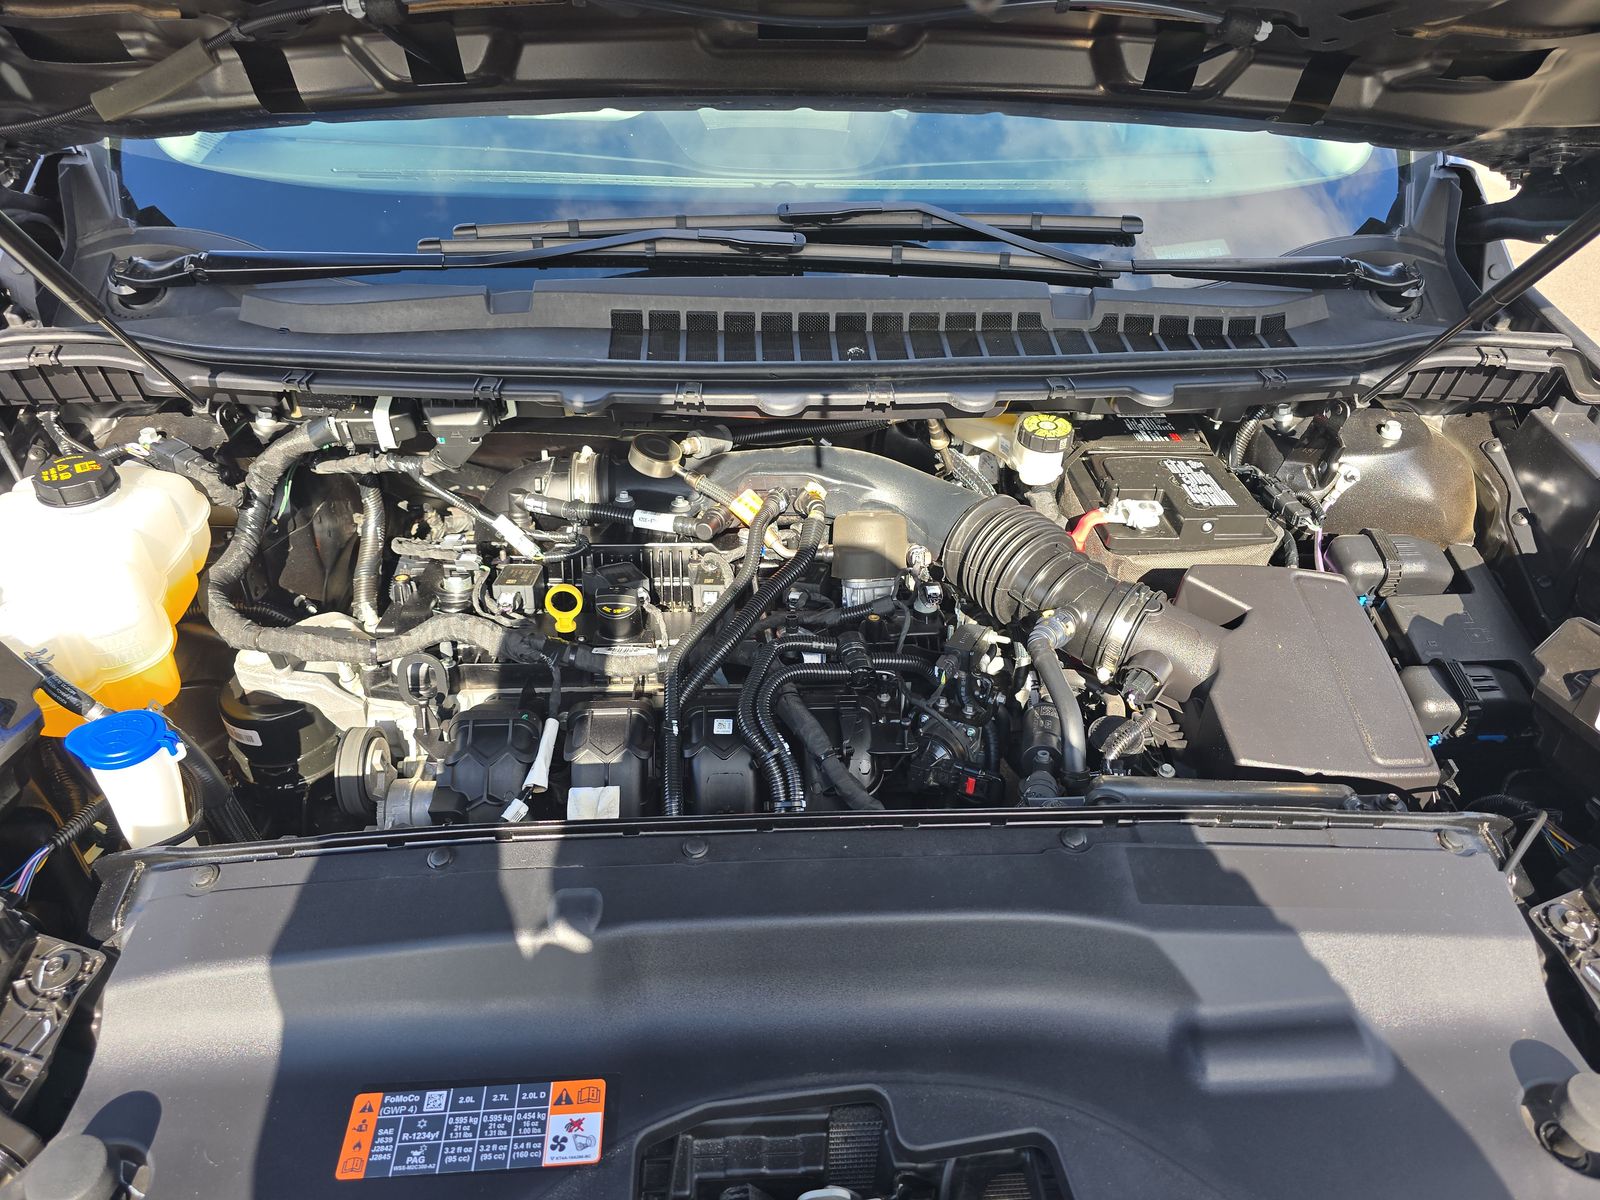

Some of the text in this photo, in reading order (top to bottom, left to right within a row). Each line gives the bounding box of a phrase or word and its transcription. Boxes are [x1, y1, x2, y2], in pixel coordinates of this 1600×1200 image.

[384, 1094, 420, 1104] FoMoCo
[458, 1096, 476, 1104] 2.0L
[492, 1094, 509, 1102] 2.7L
[522, 1092, 538, 1100] 2.0L
[380, 1105, 418, 1116] (GWP 4)
[482, 1114, 512, 1122] 0.595 kg
[516, 1112, 546, 1120] 0.454 kg
[448, 1116, 478, 1125] 0.595 kg
[378, 1128, 394, 1136] SAE
[402, 1130, 440, 1142] R-1234yf
[480, 1152, 506, 1162] (95 cc)
[512, 1150, 542, 1160] (160 cc)
[406, 1156, 426, 1164] PAG
[444, 1155, 470, 1164] (95 cc)
